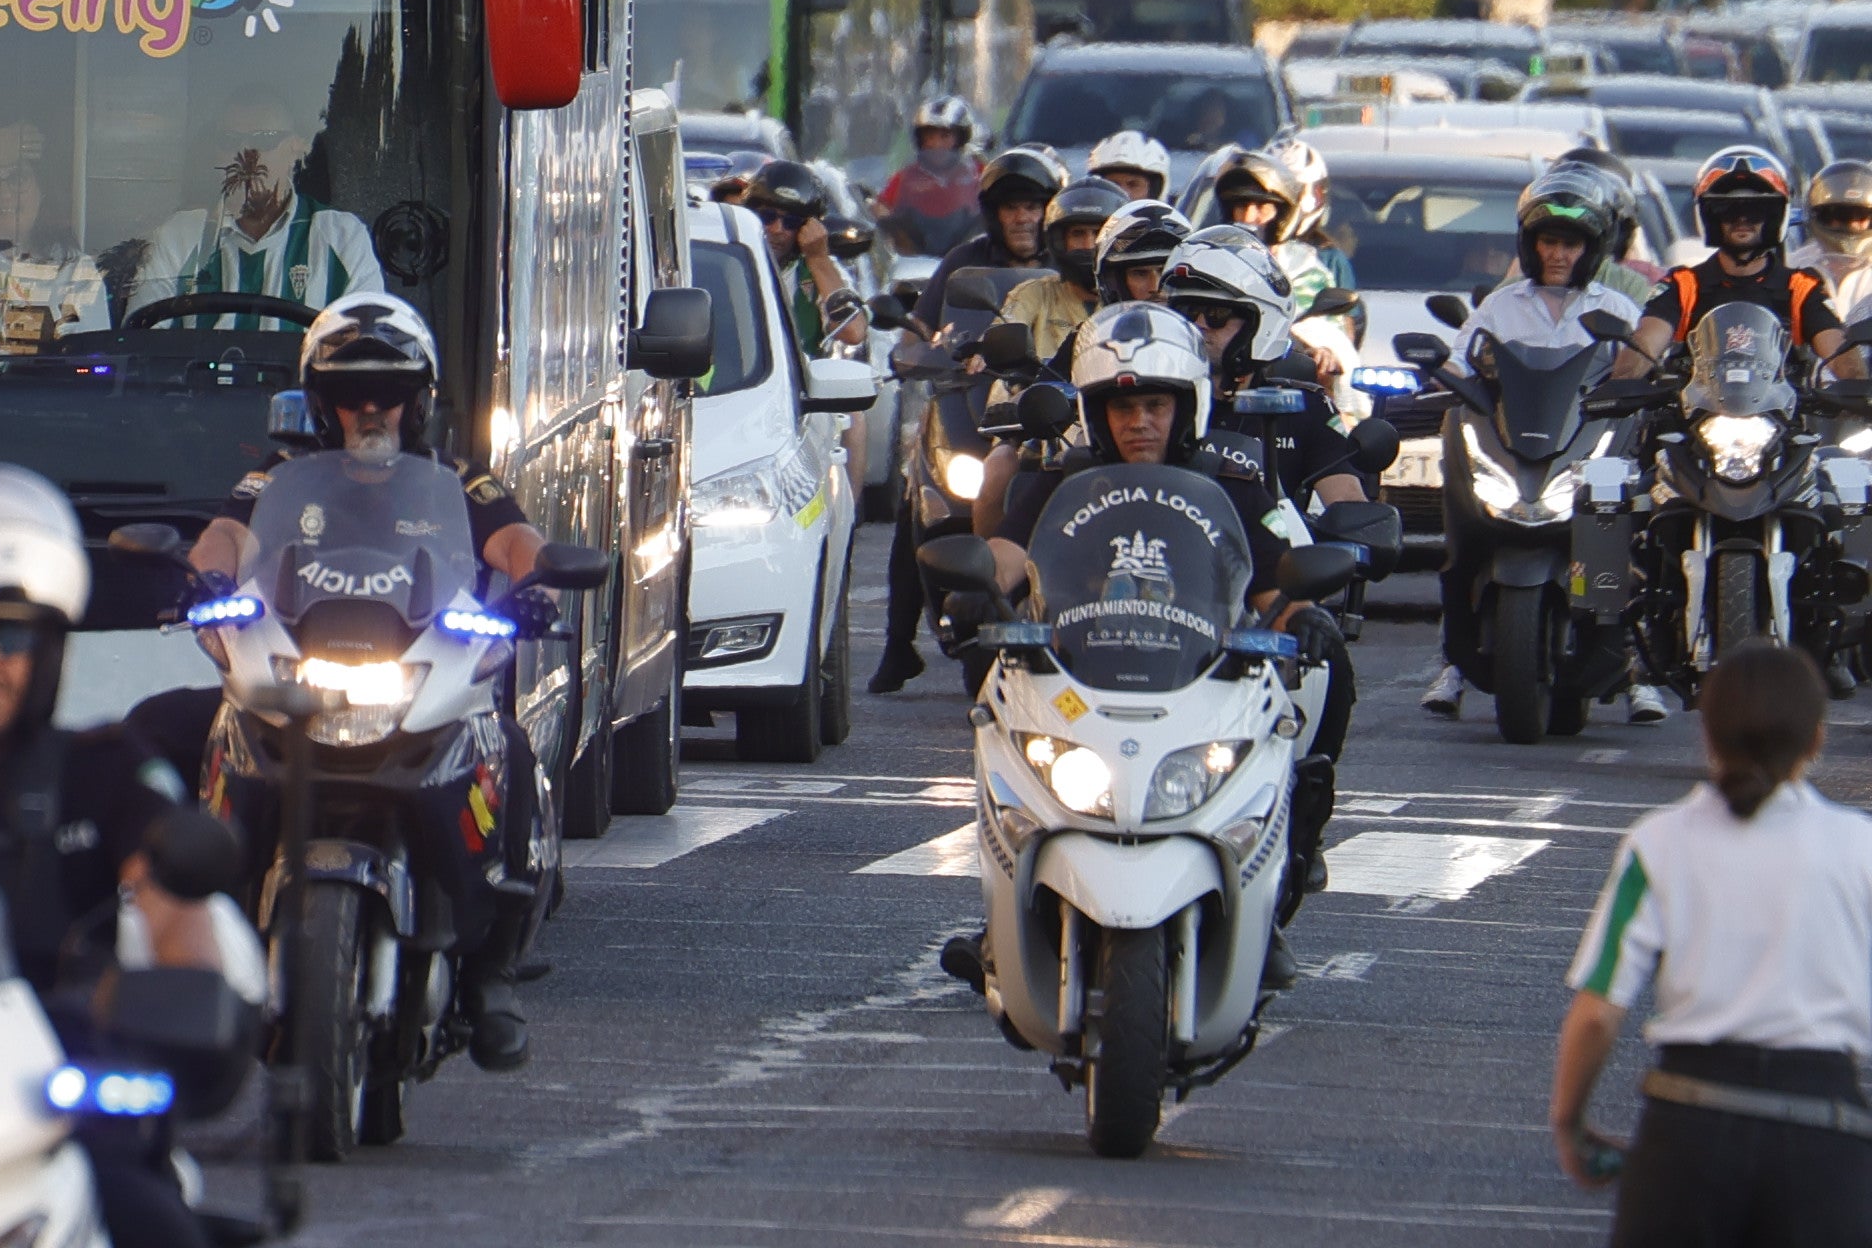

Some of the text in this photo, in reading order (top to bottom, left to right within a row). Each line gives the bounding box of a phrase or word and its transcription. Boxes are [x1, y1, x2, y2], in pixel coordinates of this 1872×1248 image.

[1062, 487, 1223, 548] POLICIA LOCAL
[1057, 598, 1147, 629] AYUNTAMIENTO
